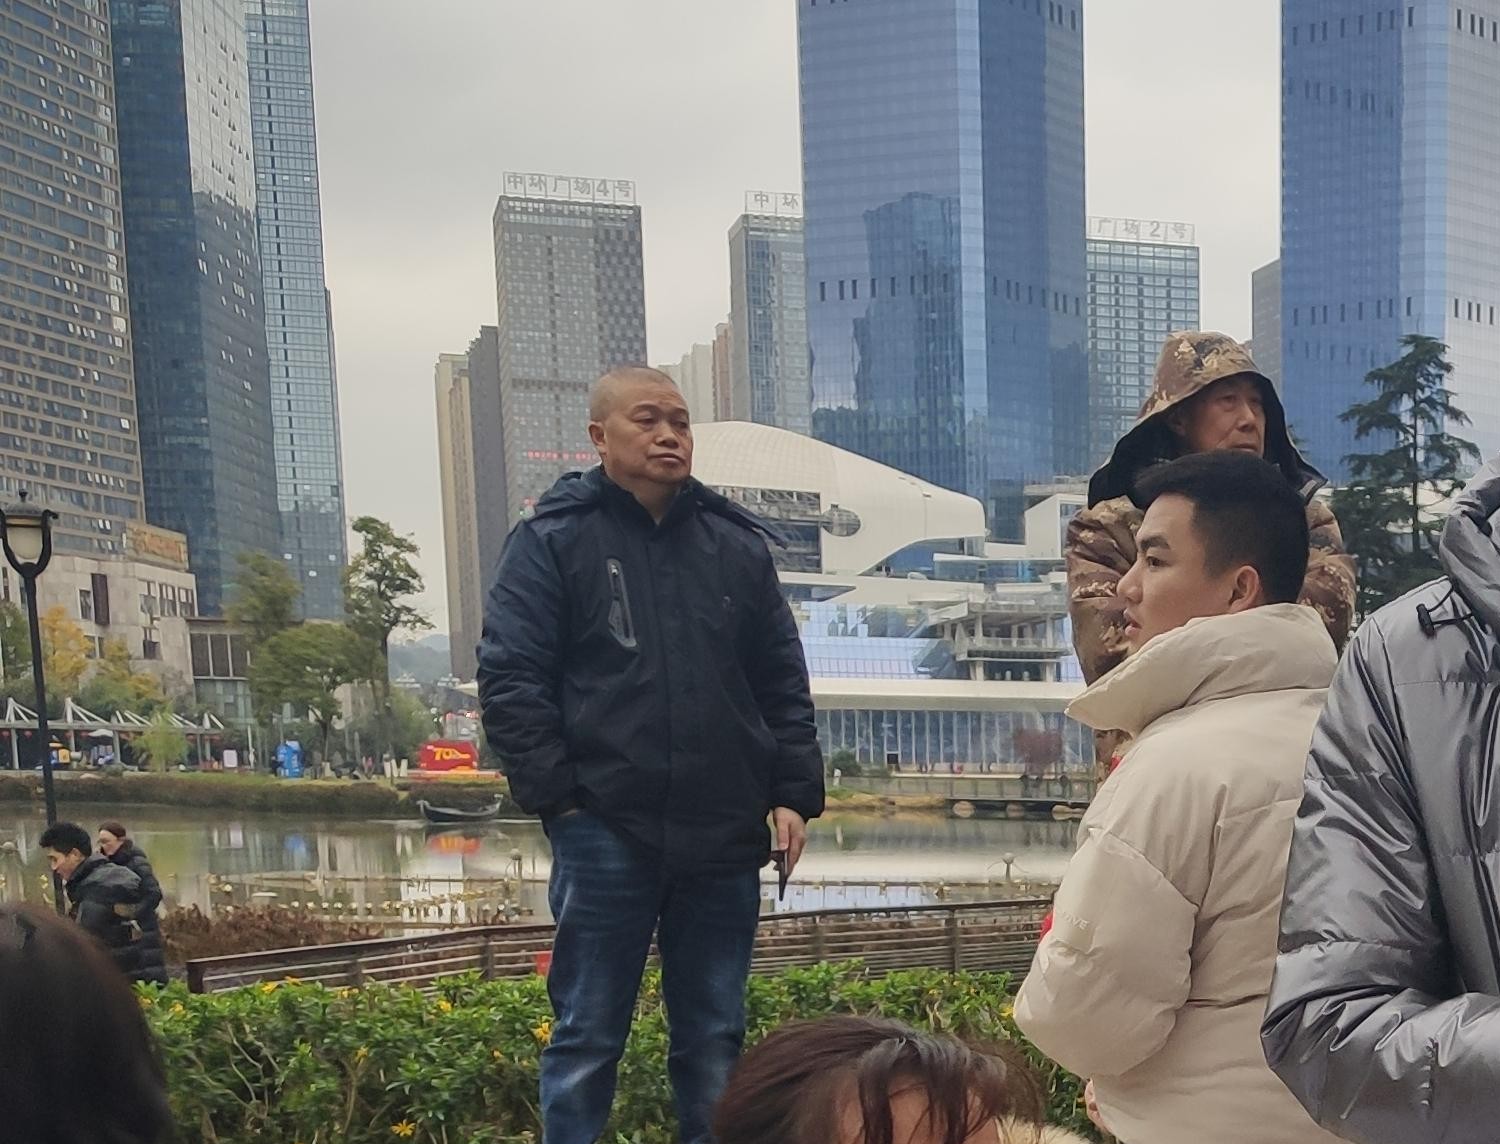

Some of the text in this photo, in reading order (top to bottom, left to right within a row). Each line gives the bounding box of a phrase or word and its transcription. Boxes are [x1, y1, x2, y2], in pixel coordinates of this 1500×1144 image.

[508, 172, 632, 198] 中环广场4号
[754, 192, 798, 210] 中环
[1097, 217, 1187, 239] 广场2号
